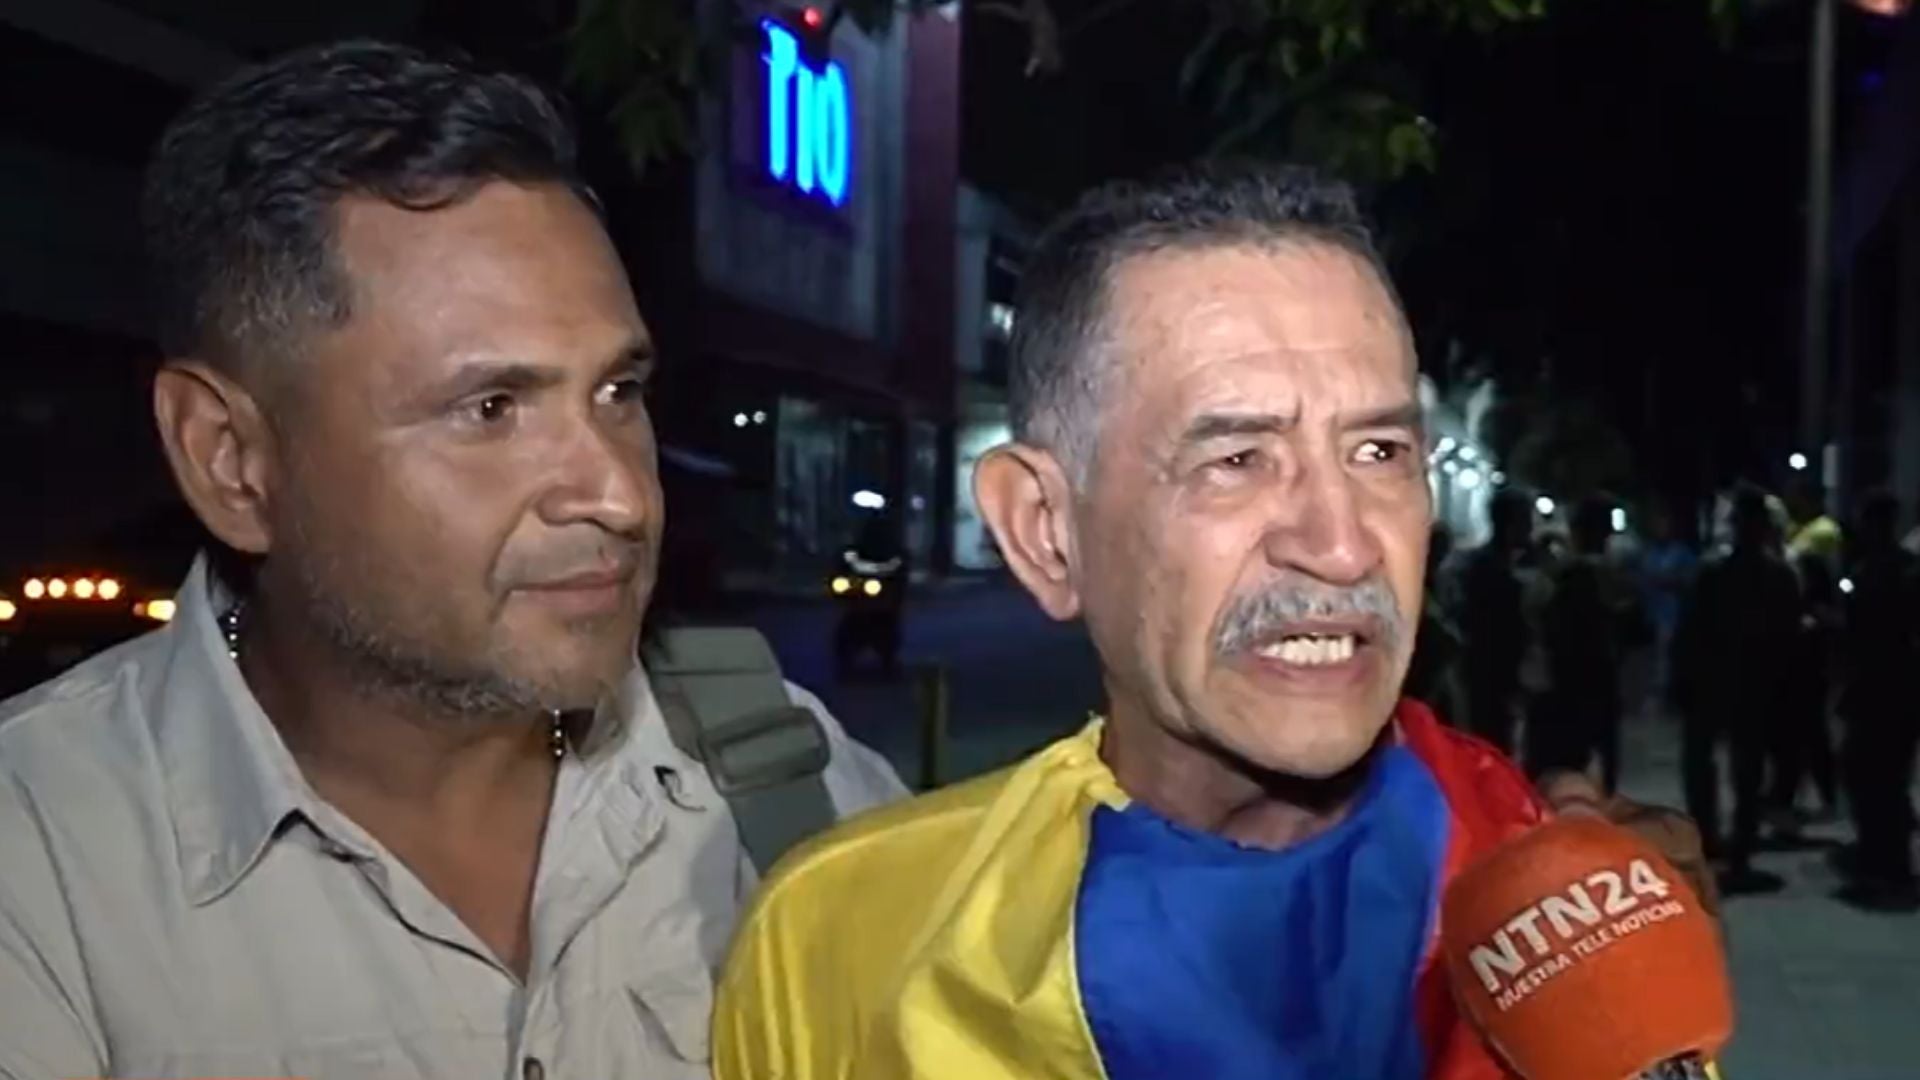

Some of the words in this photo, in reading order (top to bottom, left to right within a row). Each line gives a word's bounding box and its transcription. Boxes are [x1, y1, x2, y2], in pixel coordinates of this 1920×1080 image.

[1468, 858, 1670, 993] NTN24
[1495, 952, 1573, 1012] NUESTRA
[1571, 928, 1615, 957] TELE
